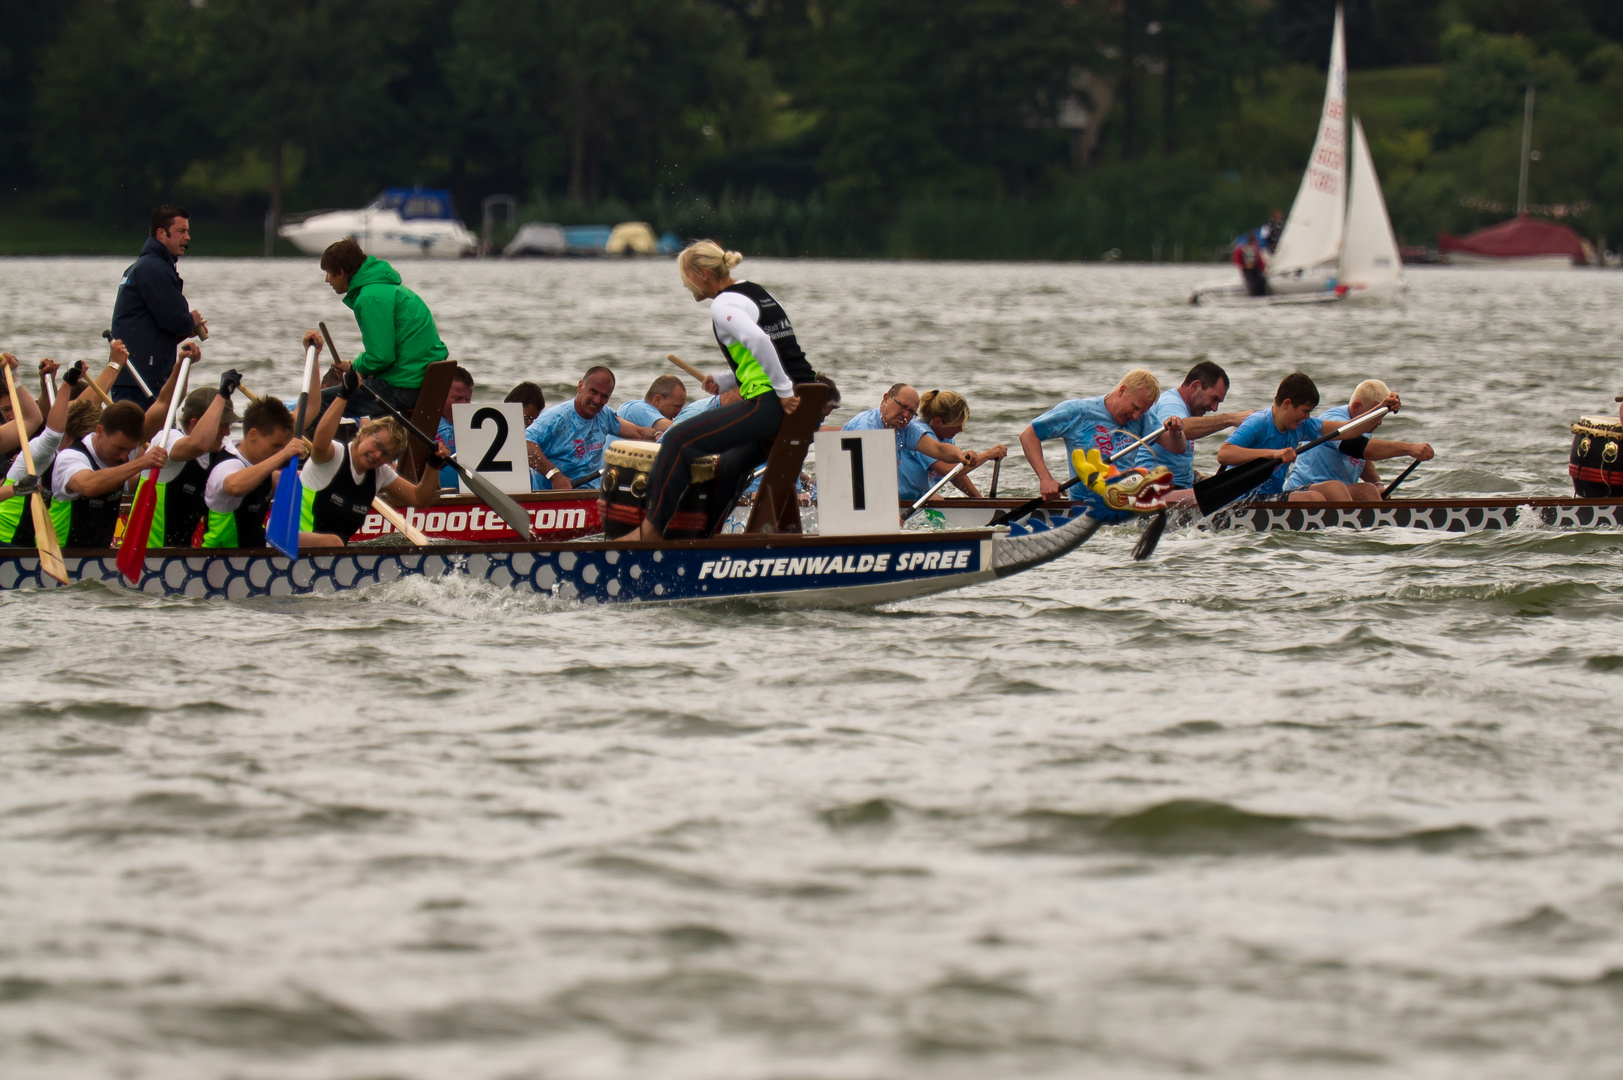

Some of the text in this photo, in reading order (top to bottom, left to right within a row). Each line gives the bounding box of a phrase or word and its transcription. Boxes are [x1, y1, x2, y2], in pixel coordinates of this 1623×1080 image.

[470, 406, 513, 472] 2
[840, 437, 866, 511] 1
[698, 550, 971, 579] FÜRSTENWALDE SPREE
